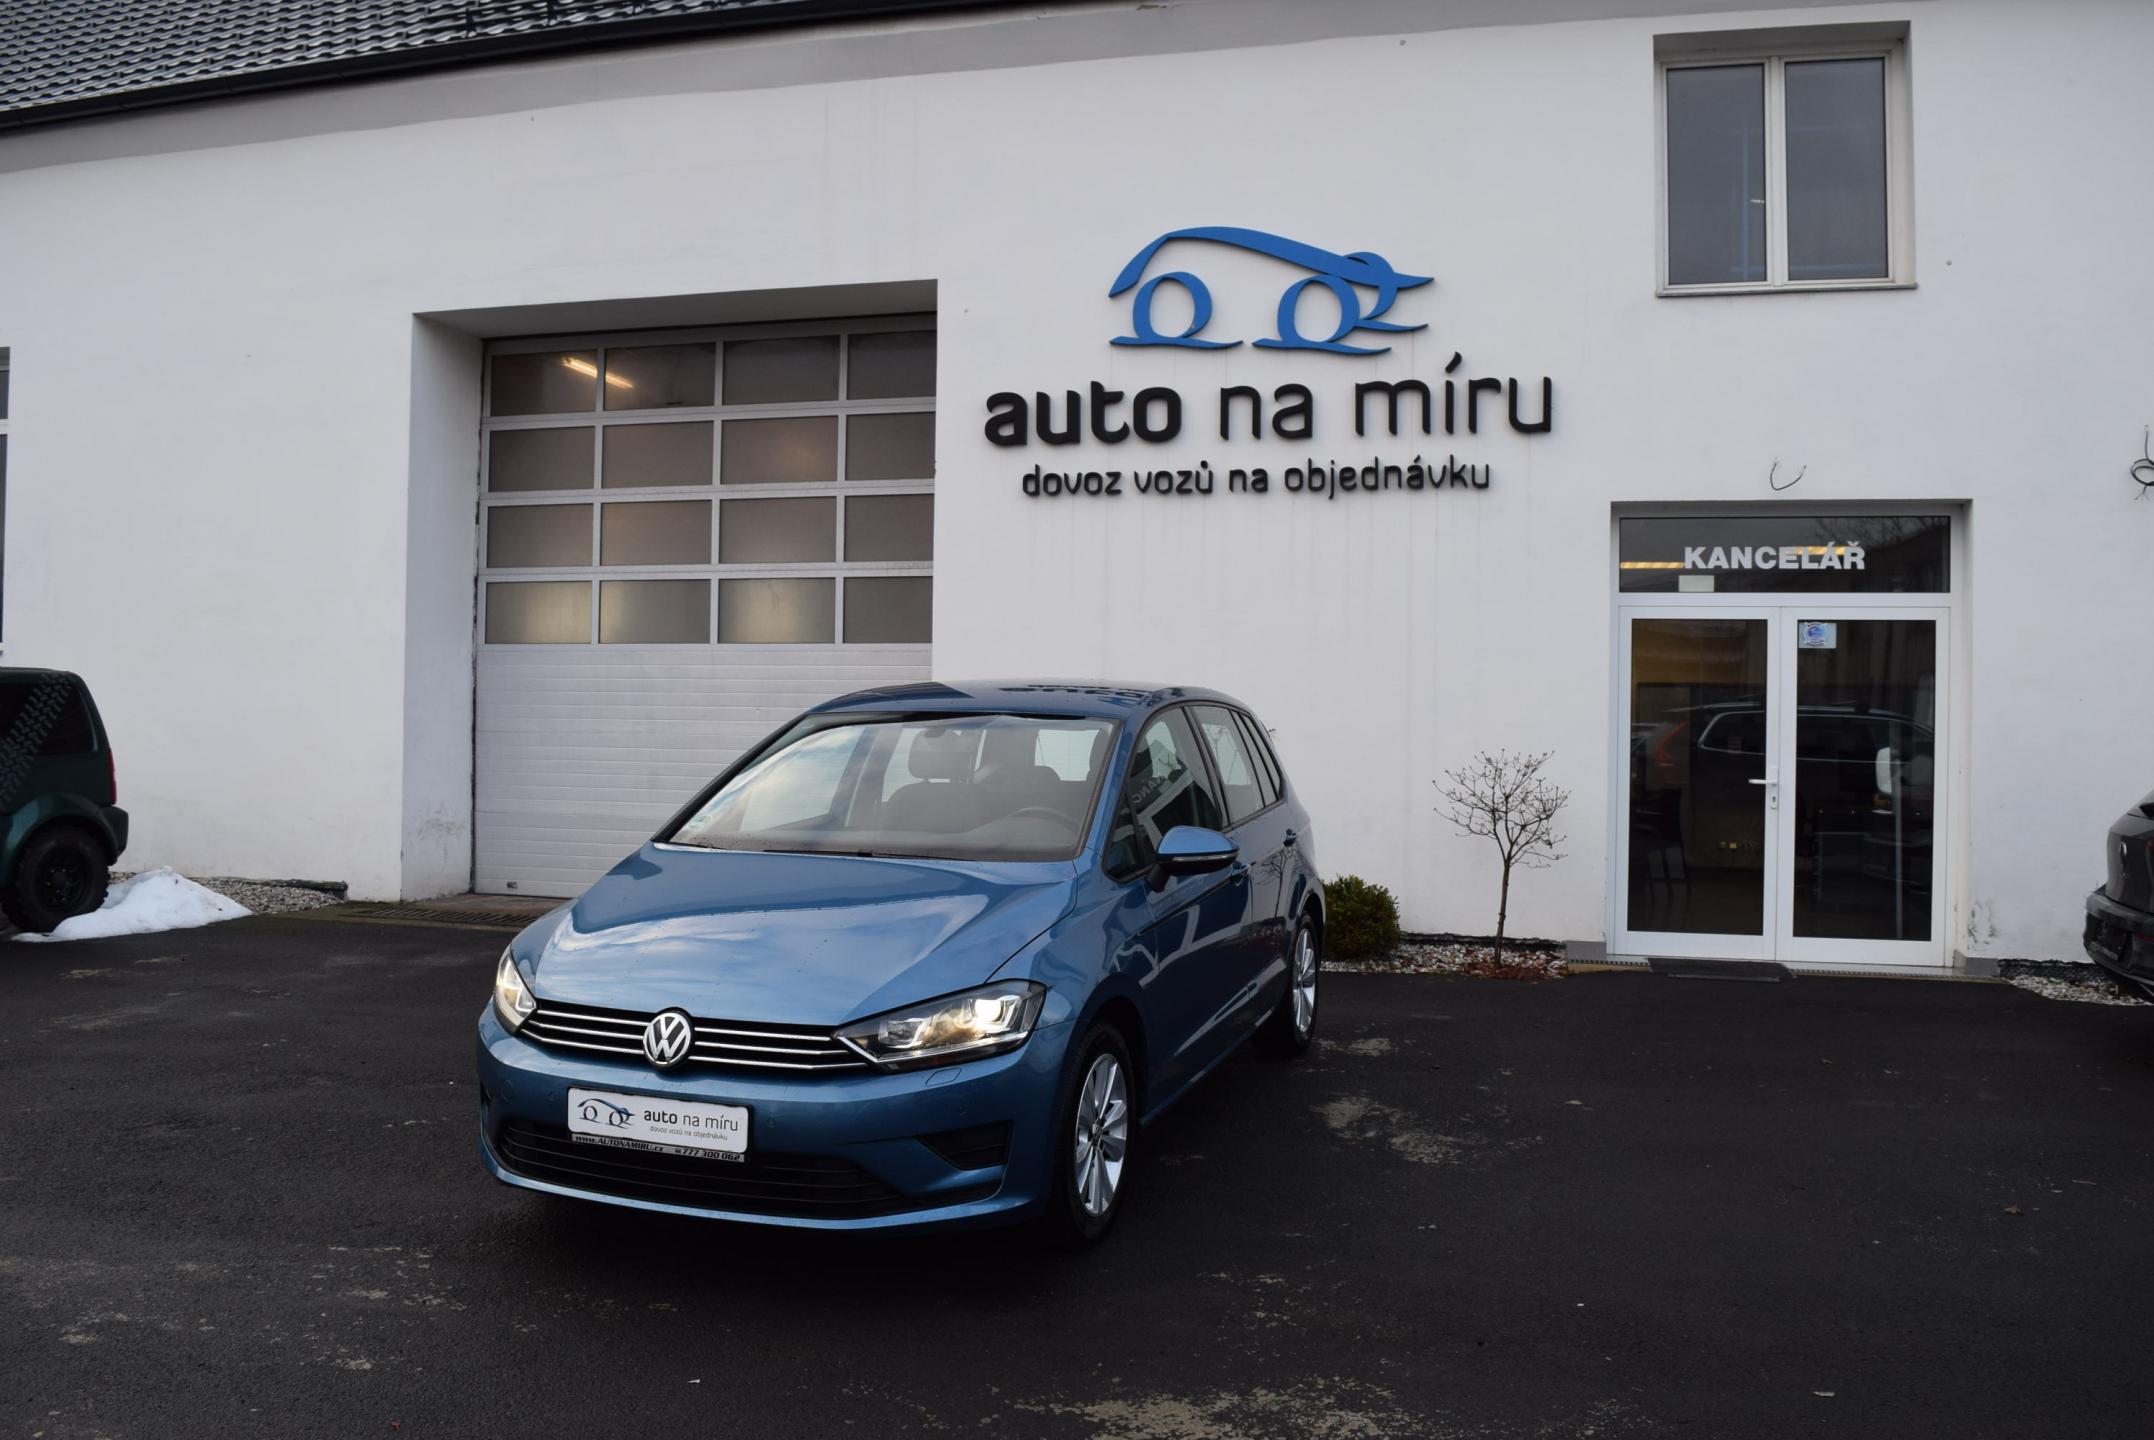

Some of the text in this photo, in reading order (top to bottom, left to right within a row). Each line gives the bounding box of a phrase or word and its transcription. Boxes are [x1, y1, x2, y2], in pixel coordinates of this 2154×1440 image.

[984, 351, 1553, 449] auto na míru
[1022, 454, 1491, 501] dovoz vozů na objednávku
[1683, 540, 1866, 571] KANCELÁŘ
[643, 1110, 738, 1132] auto na míru
[649, 1124, 668, 1133] dovoz
[684, 1129, 692, 1137] na
[693, 1131, 728, 1141] objednávku
[701, 1149, 720, 1159] 300
[721, 1152, 740, 1161] 062
